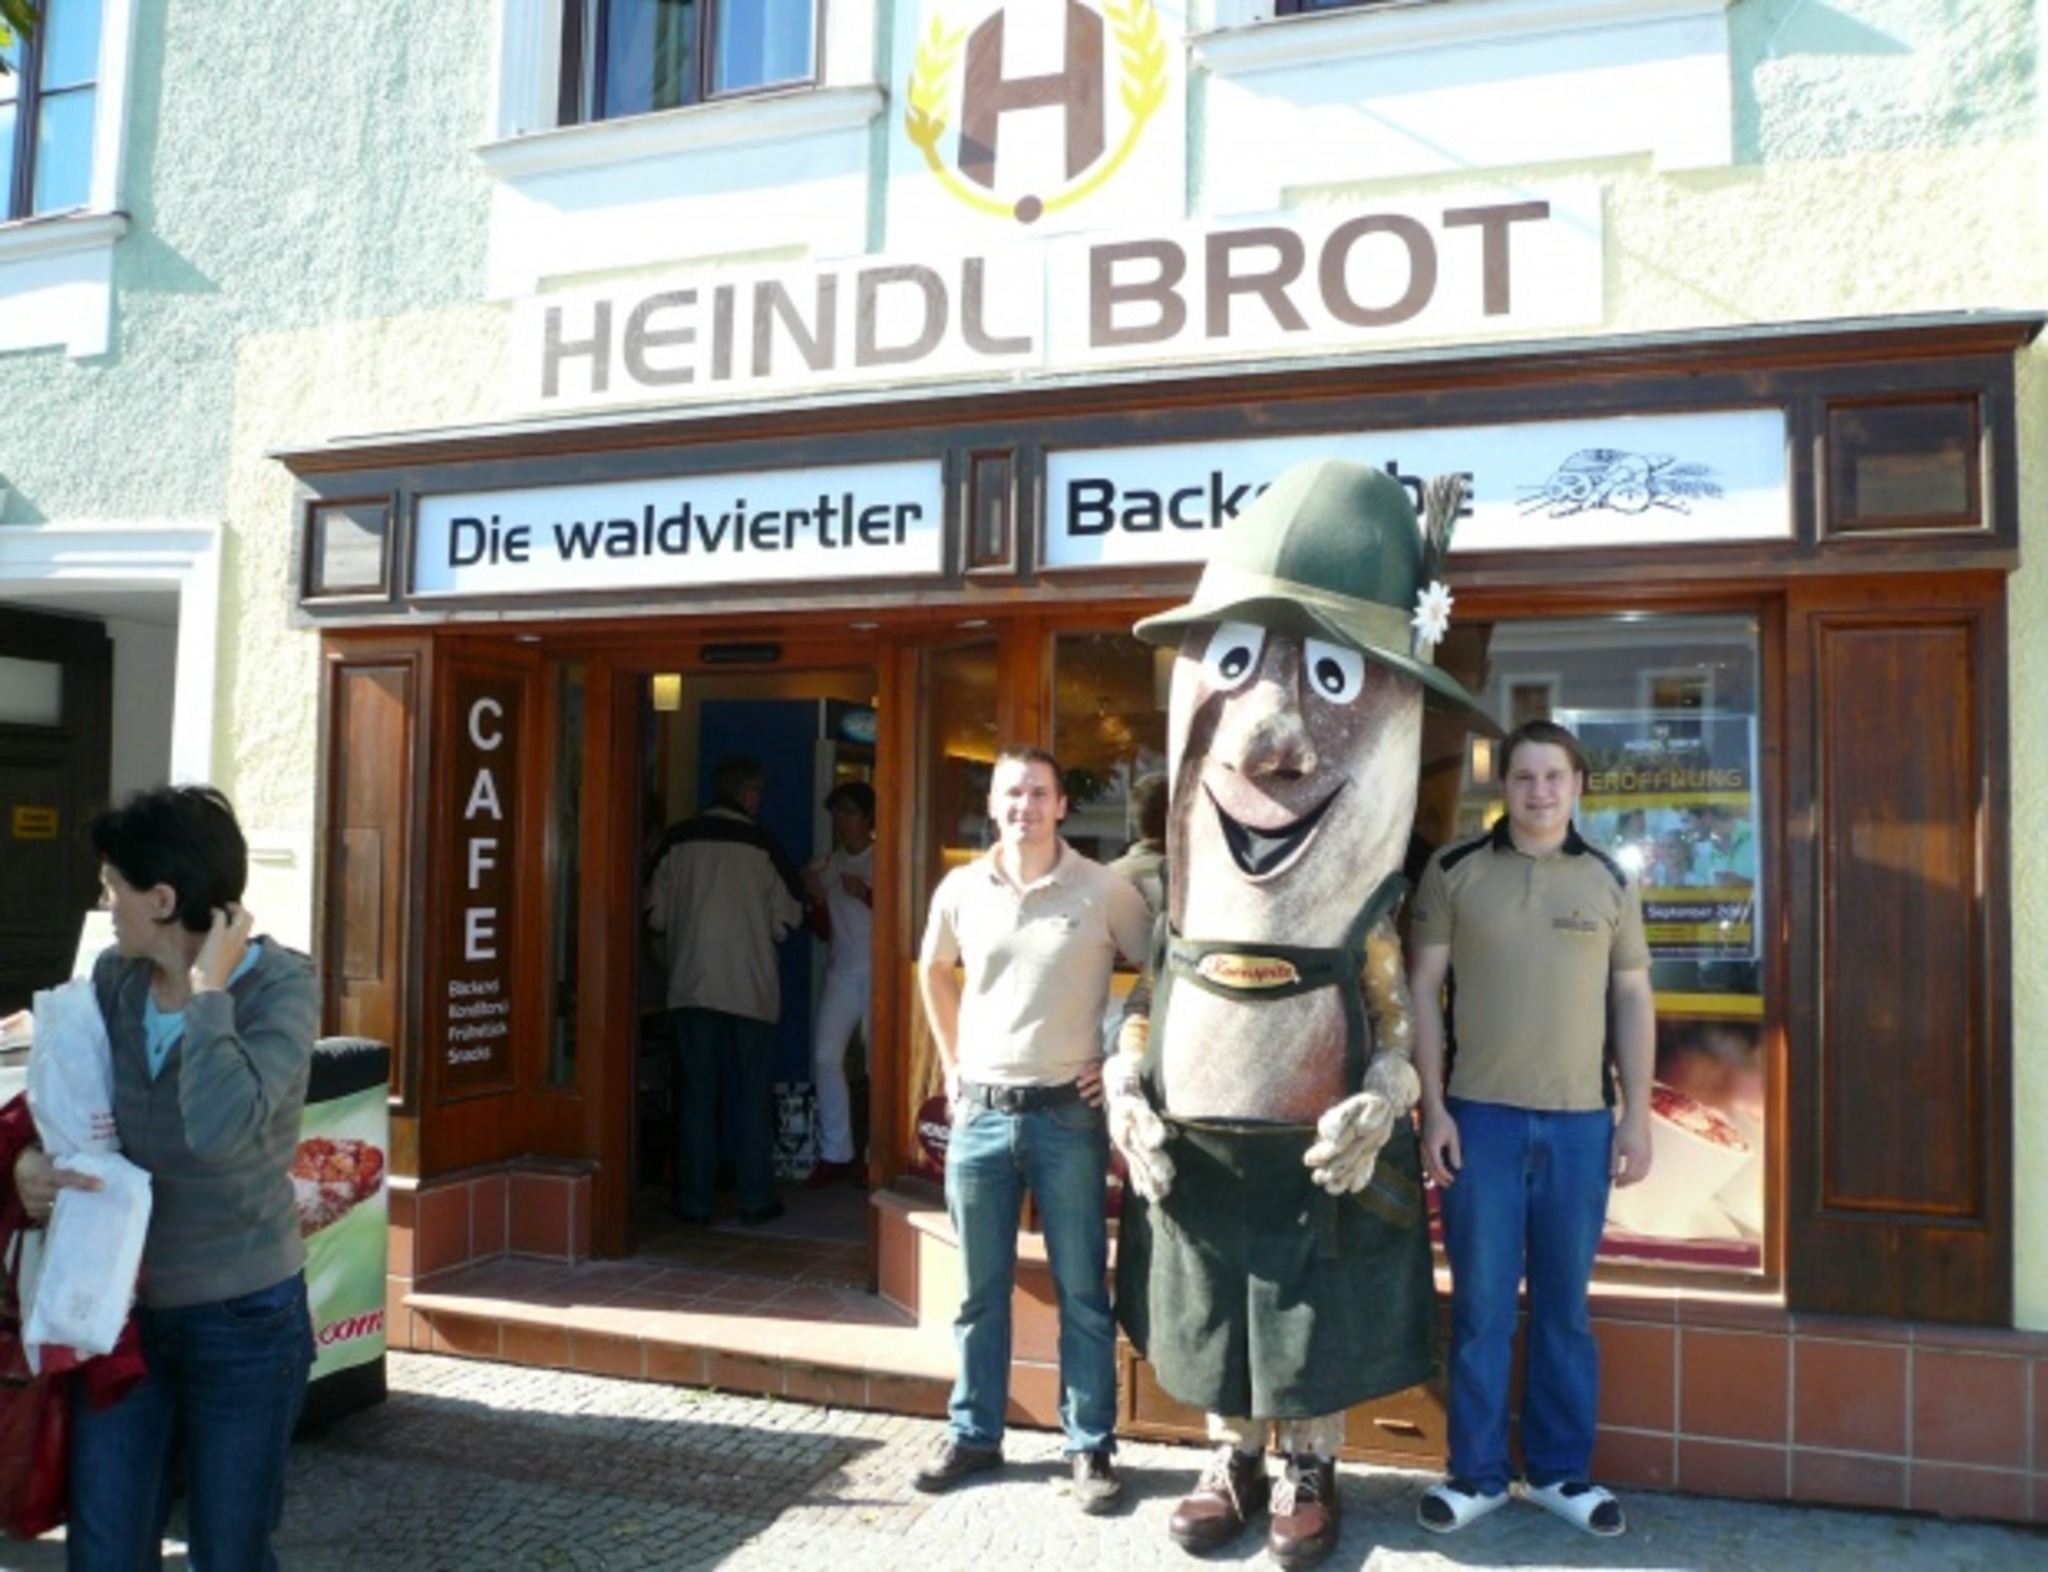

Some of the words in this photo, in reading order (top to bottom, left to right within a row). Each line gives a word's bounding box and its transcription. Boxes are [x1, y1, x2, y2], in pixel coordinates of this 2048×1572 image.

[956, 0, 1106, 190] H
[541, 256, 1033, 398] HEINDL
[1089, 200, 1551, 348] BROT
[448, 514, 531, 567] Die
[554, 492, 923, 560] waldviertler
[464, 696, 503, 961] CAFE
